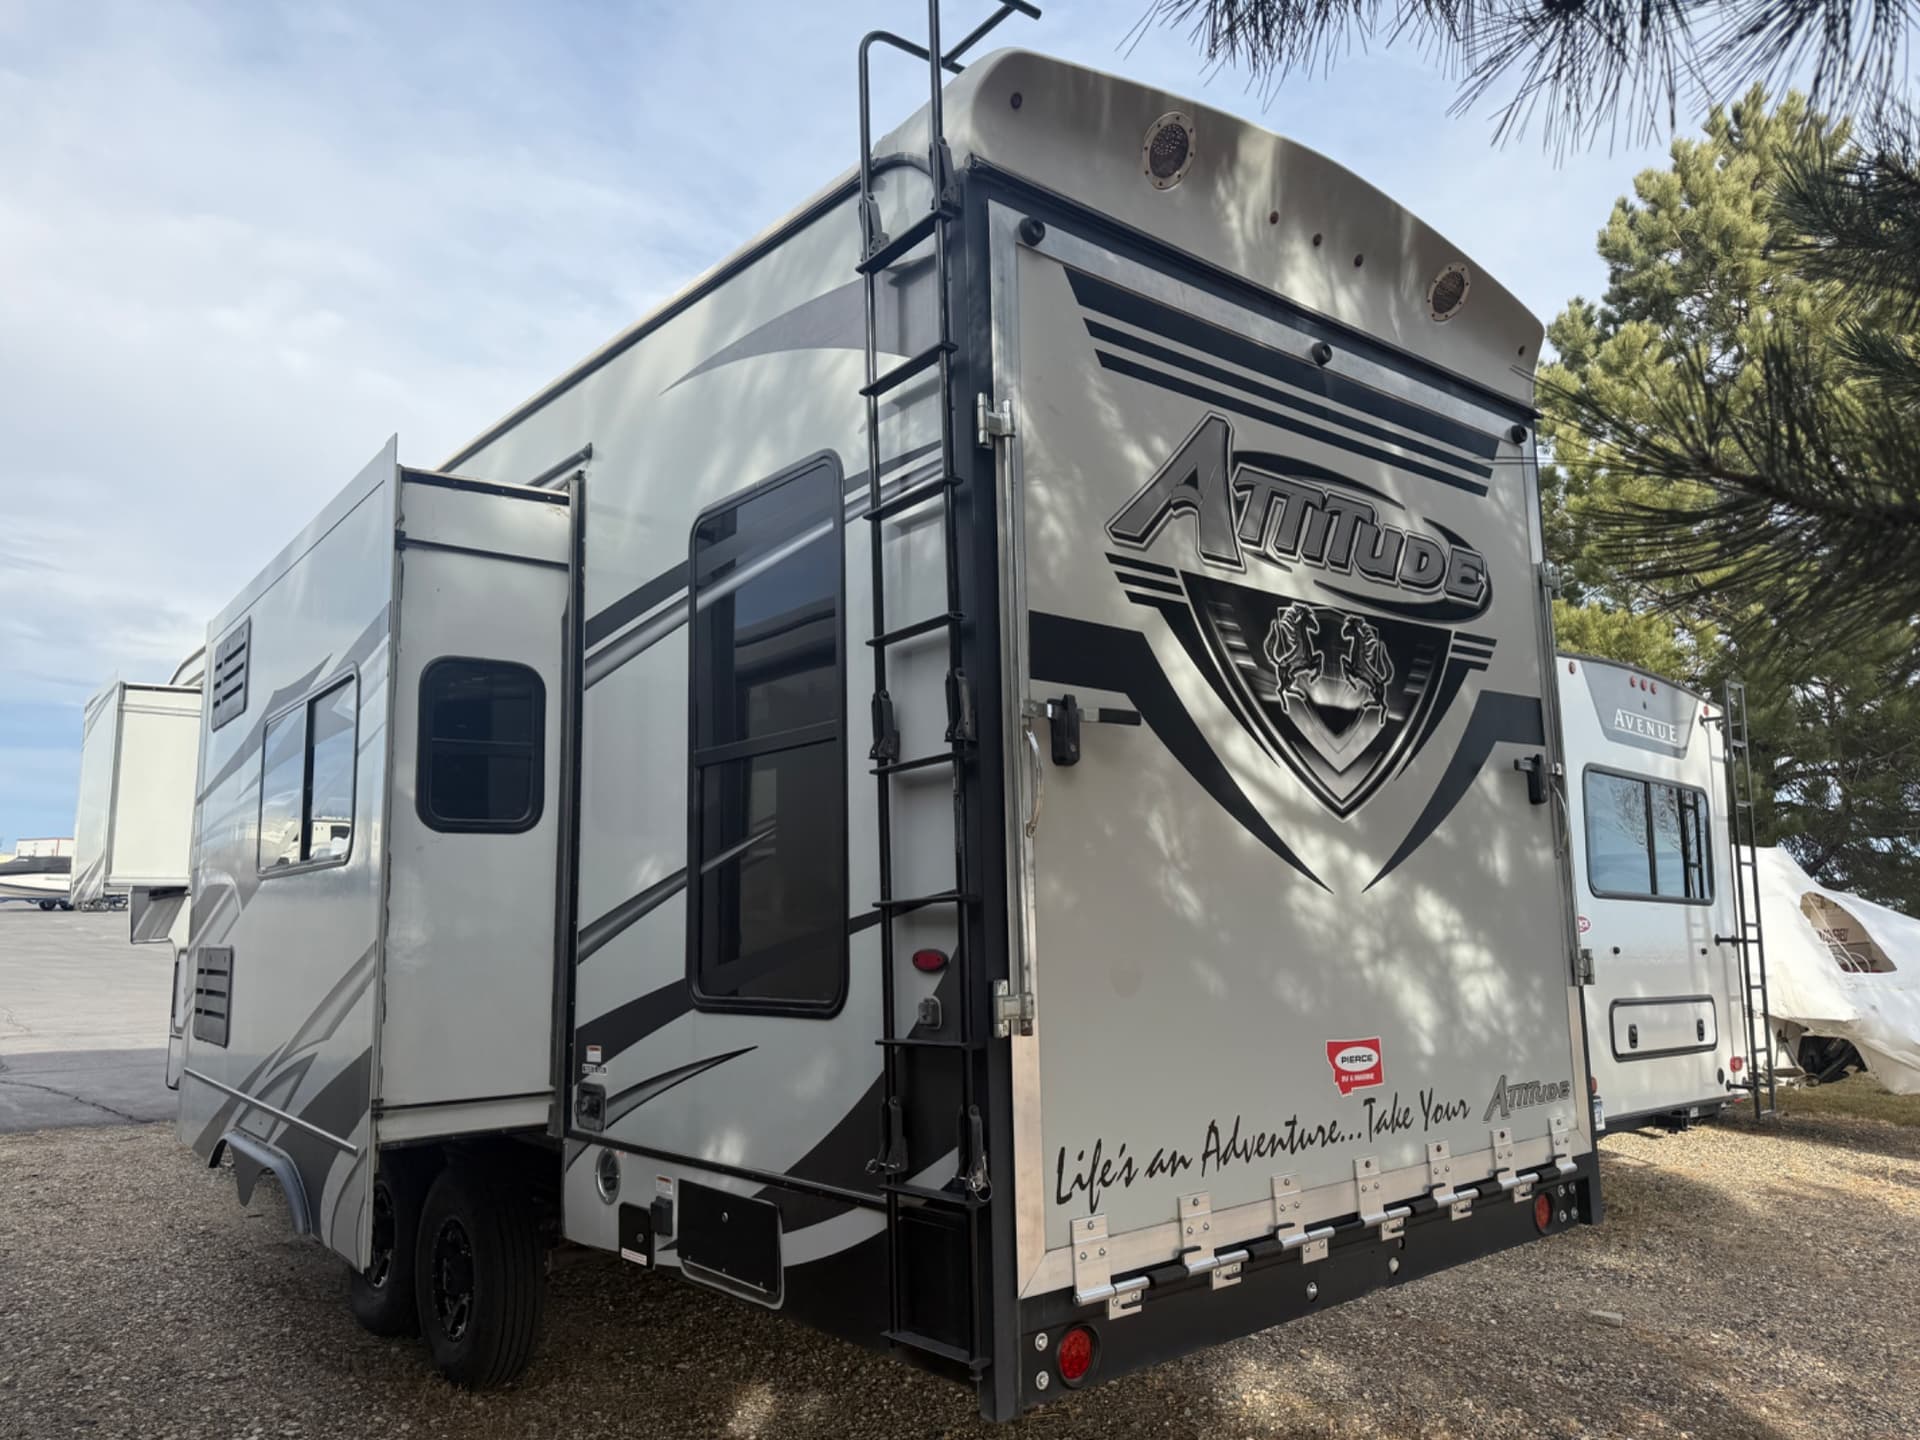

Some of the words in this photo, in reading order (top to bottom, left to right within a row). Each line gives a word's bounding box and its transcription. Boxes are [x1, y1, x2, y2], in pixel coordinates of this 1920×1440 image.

[1105, 410, 1489, 606] ATTITUDE
[1614, 708, 1678, 743] AVENUE
[1341, 1054, 1373, 1064] PIERCE
[1056, 1138, 1139, 1214] Life's
[1144, 1148, 1192, 1178] an
[1420, 1088, 1470, 1132] Your
[1482, 1074, 1571, 1124] ATTITUDE
